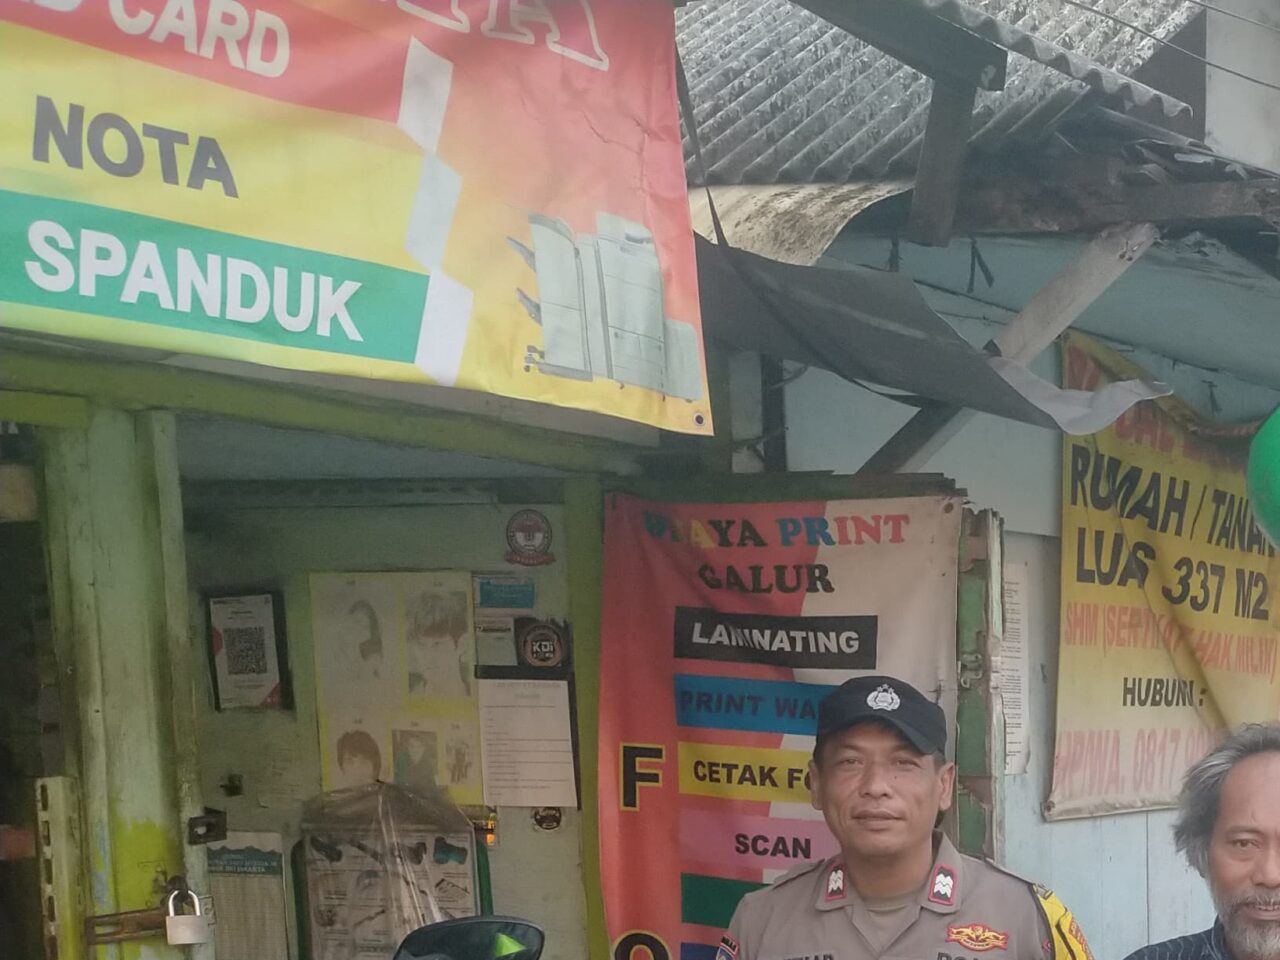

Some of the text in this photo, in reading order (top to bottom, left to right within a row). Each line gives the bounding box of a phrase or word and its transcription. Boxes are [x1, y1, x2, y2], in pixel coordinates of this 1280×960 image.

[108, 0, 290, 78] CARD
[32, 94, 239, 199] NOTA
[24, 218, 364, 342] SPANDUK
[776, 513, 911, 547] PRINT
[699, 563, 835, 595] GALUR
[1161, 556, 1226, 615] 337
[1234, 567, 1269, 621] M2
[680, 689, 817, 720] PRINT WA
[693, 759, 812, 790] CETAK FO
[735, 832, 811, 859] SCAN
